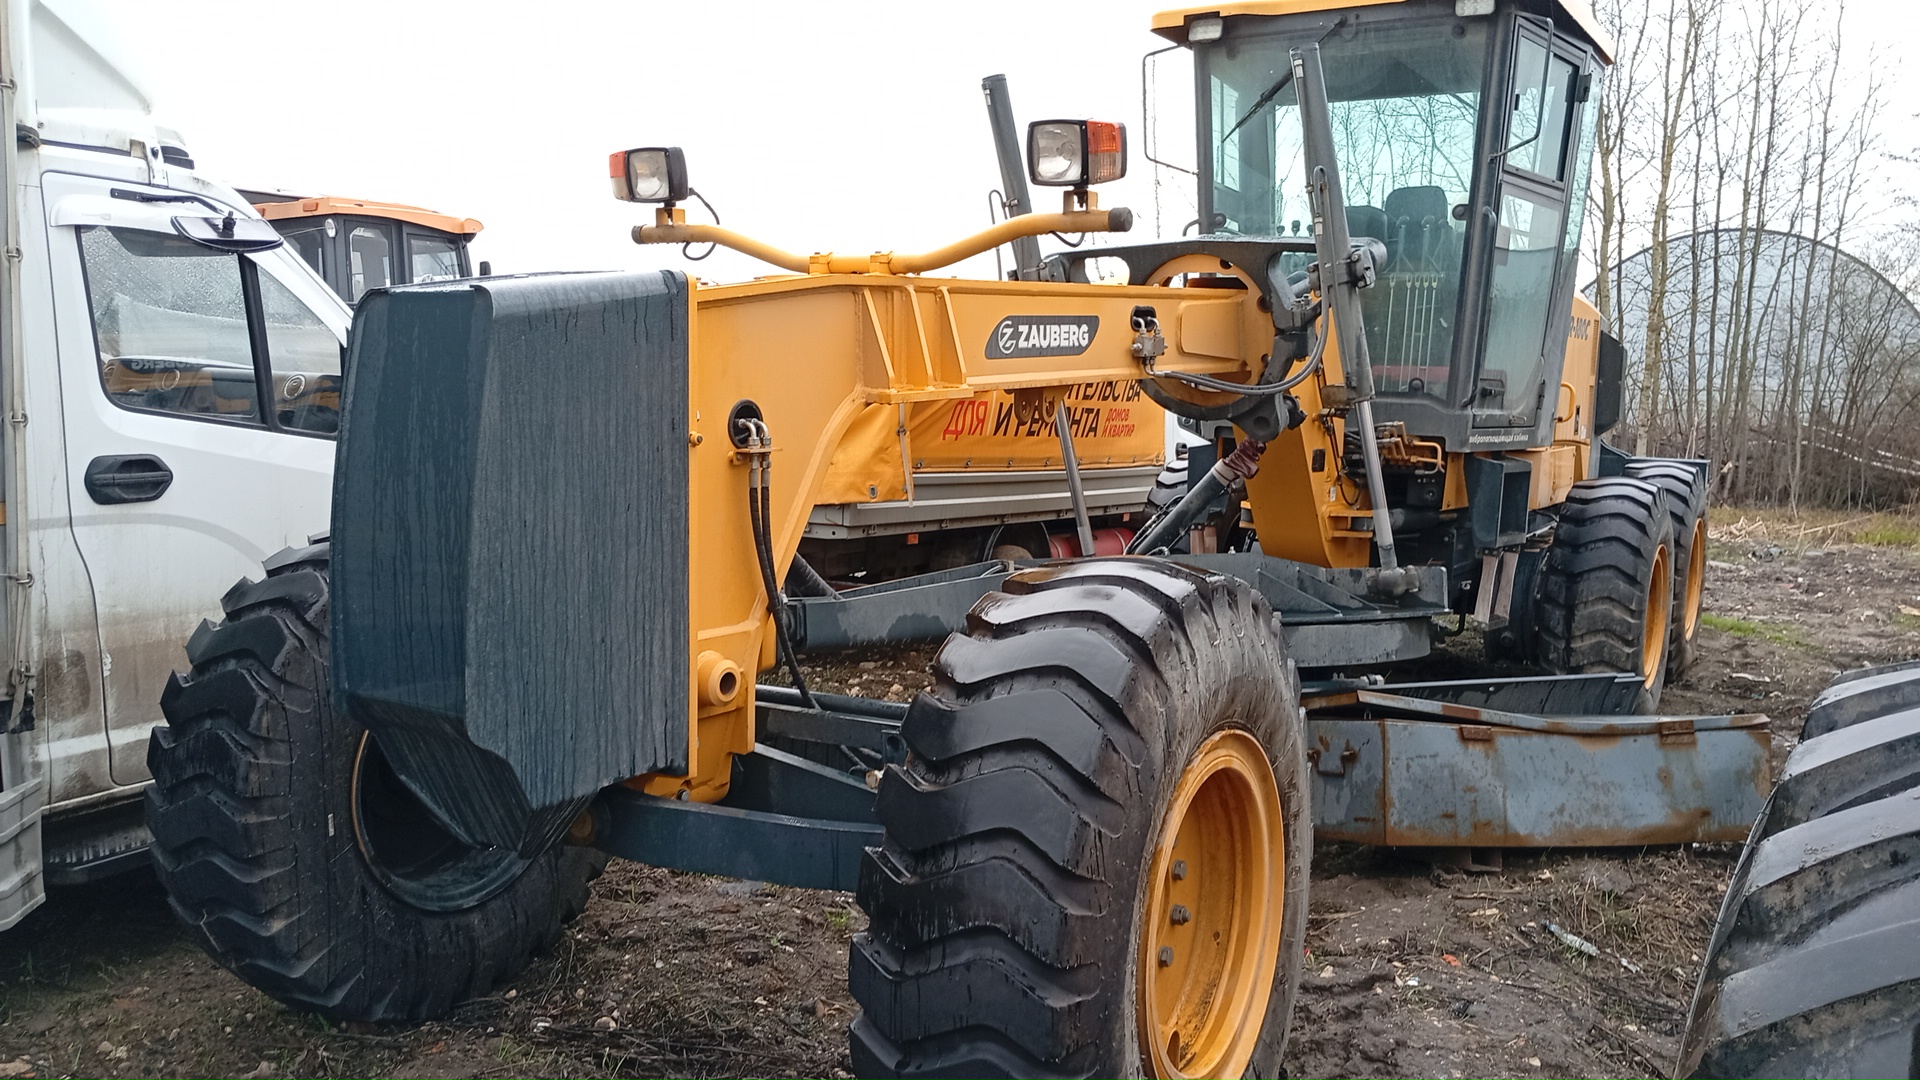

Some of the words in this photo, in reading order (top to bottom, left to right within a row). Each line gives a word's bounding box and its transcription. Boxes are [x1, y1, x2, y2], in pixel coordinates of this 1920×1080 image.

[1018, 324, 1088, 348] ZAUBERG
[943, 401, 988, 440] ДЛЯ
[993, 402, 1014, 436] И
[1105, 408, 1129, 424] ДОМОВ
